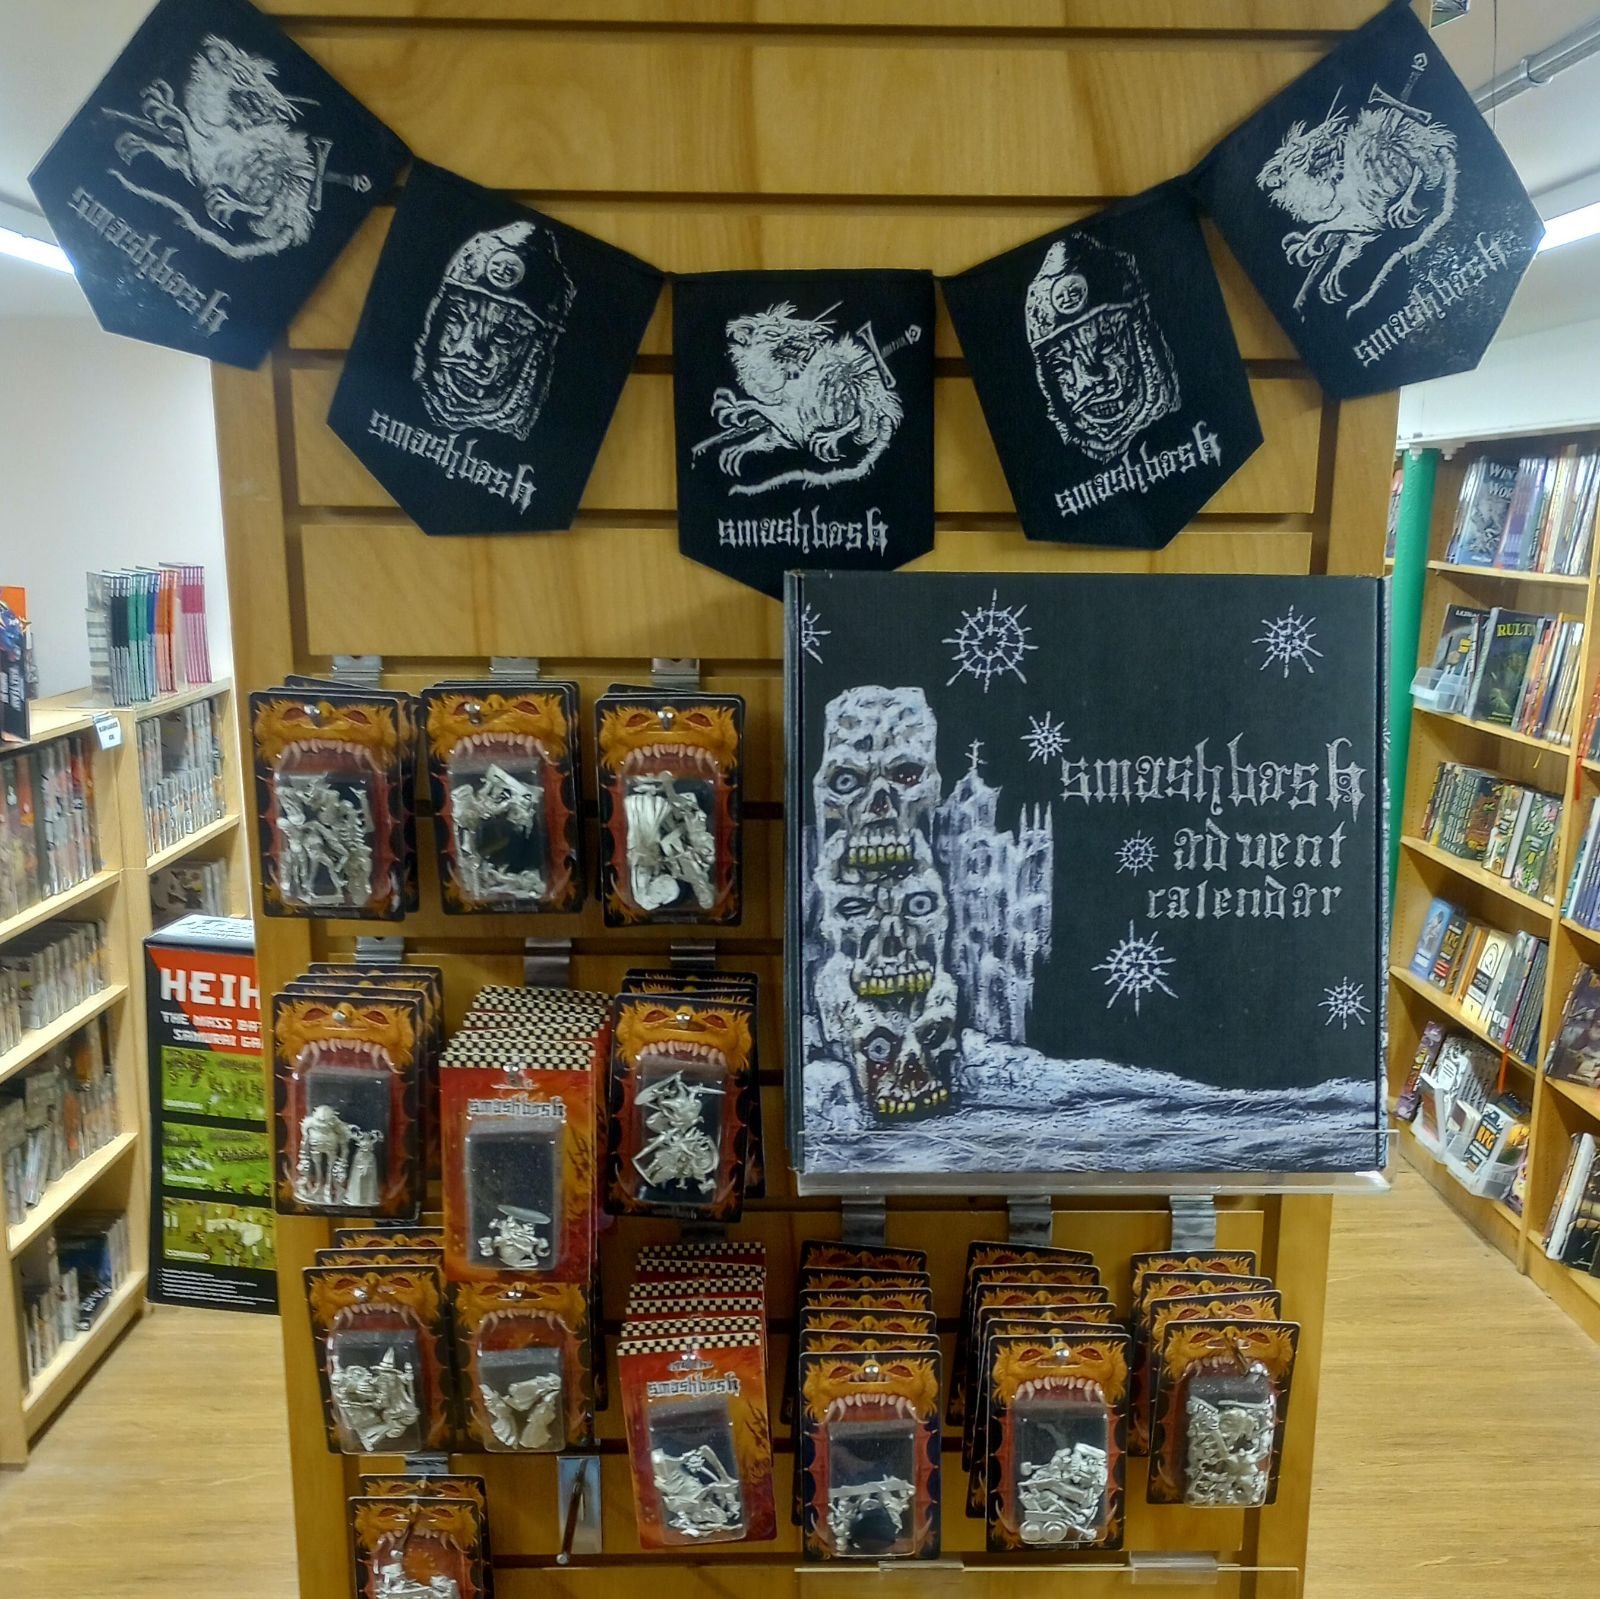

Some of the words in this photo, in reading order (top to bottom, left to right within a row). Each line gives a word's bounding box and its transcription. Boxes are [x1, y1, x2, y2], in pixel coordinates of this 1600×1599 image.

[1173, 817, 1348, 871] advent
[1146, 874, 1343, 919] calendar
[160, 1010, 190, 1026] THE
[240, 1035, 263, 1049] GA
